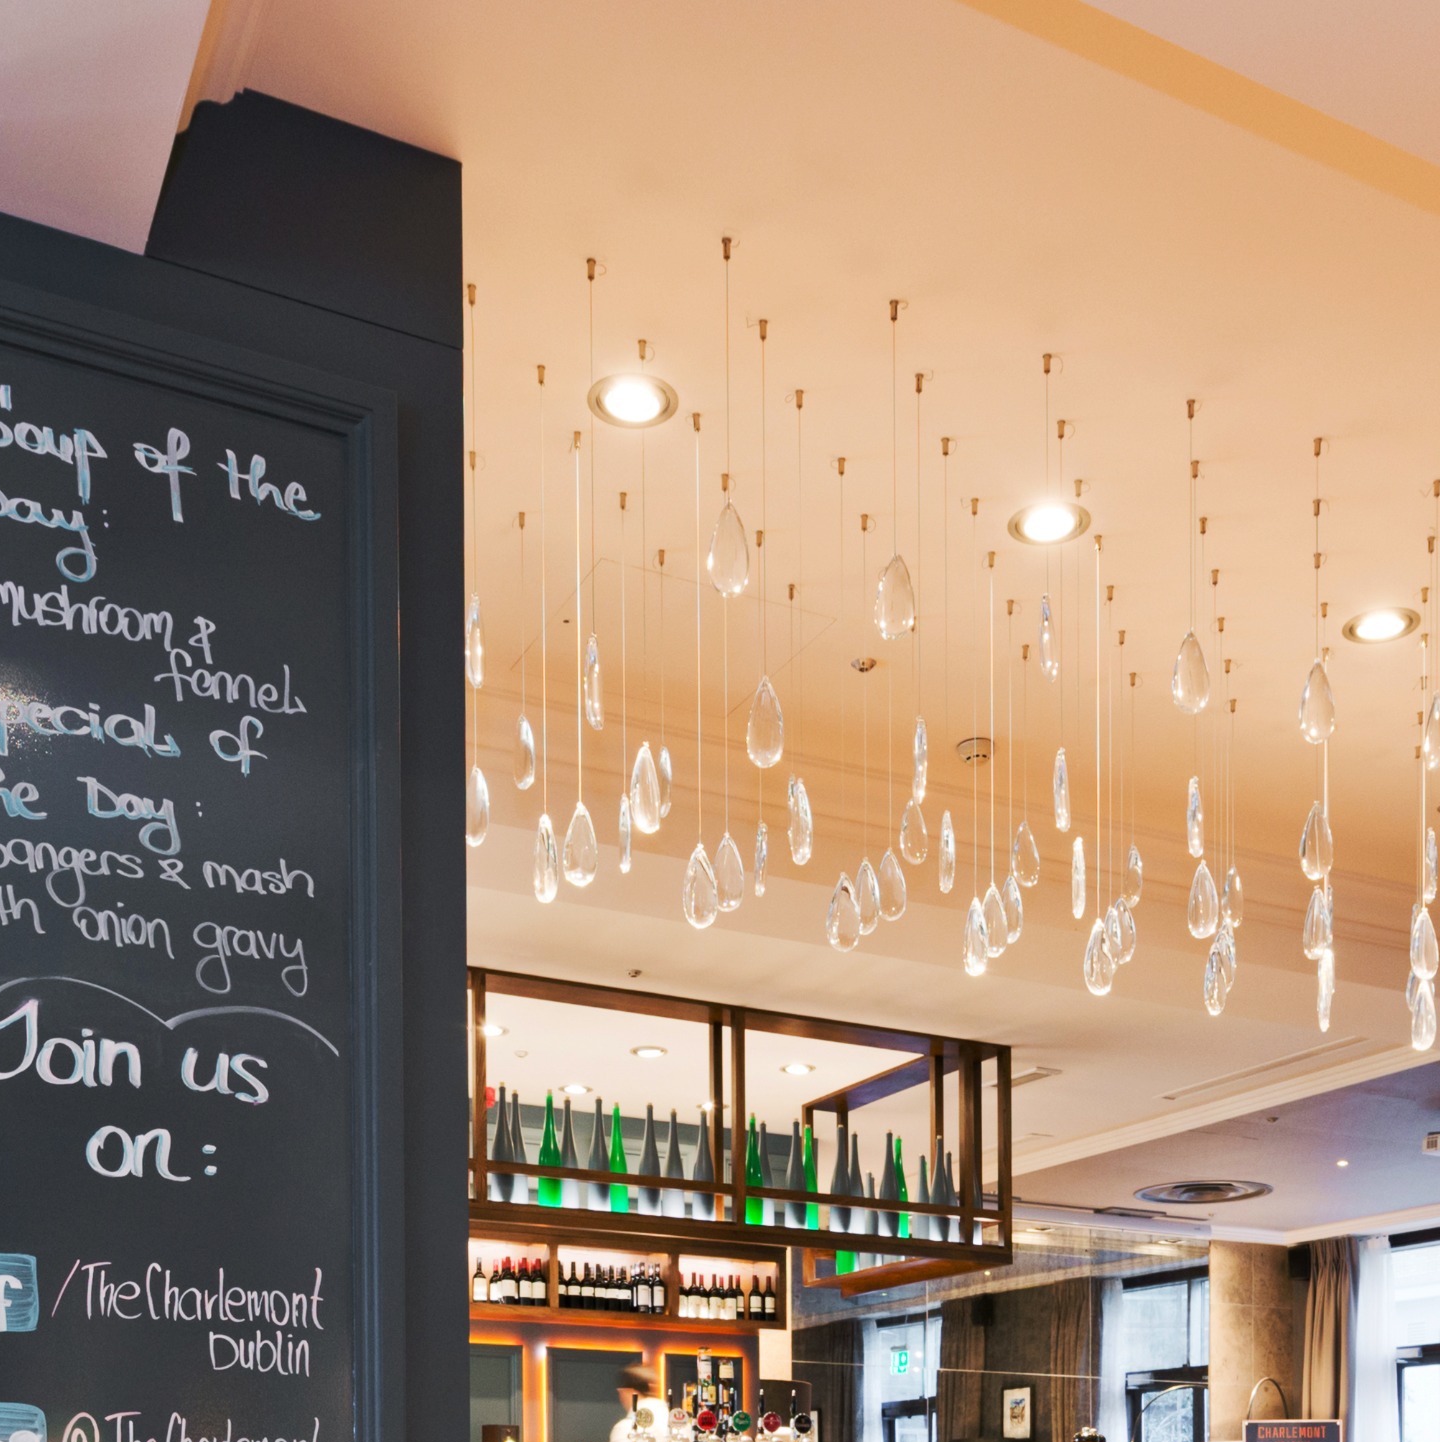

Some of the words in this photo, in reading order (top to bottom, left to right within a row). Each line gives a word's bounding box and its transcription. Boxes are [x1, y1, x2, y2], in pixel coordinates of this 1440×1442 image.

[133, 427, 197, 523] of
[217, 448, 322, 521] the
[154, 648, 307, 713] fennel
[209, 714, 268, 777] of
[158, 858, 191, 890] &
[202, 857, 315, 898] mash
[72, 901, 175, 960] onion
[192, 920, 308, 998] gravy
[180, 1046, 270, 1105] us
[208, 1330, 311, 1378] Dublin
[1257, 1425, 1327, 1439] CHARLEMONT
